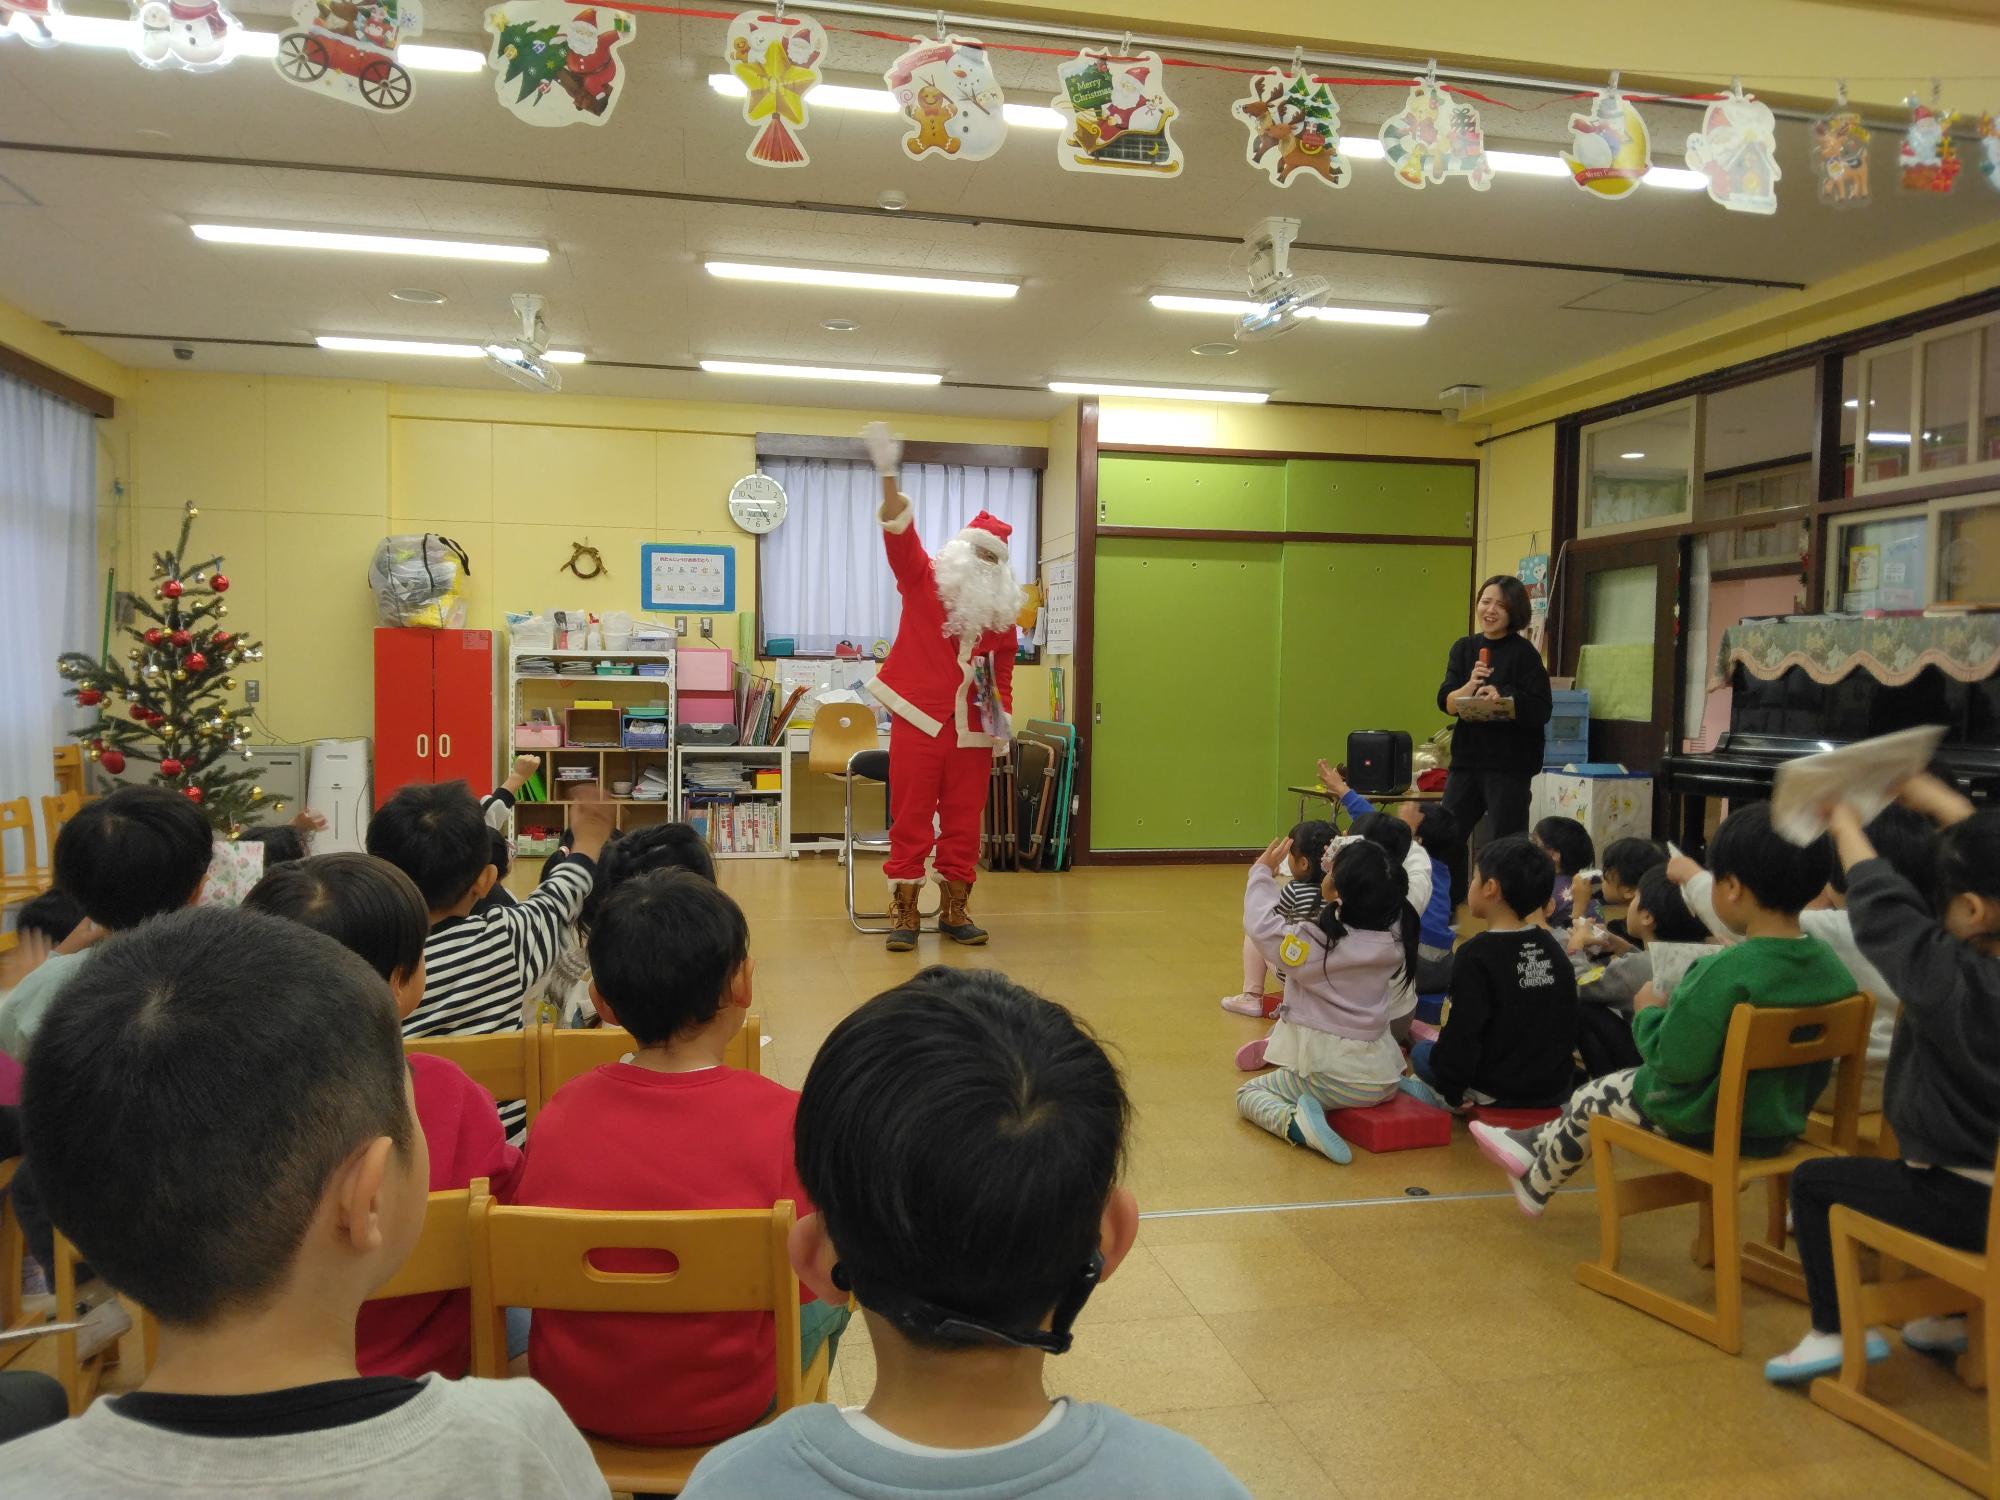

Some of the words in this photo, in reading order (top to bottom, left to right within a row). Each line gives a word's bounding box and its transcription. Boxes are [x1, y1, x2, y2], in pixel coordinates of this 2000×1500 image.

[1077, 79, 1101, 91] Merry
[1073, 87, 1112, 102] Christmas
[755, 481, 762, 489] 12
